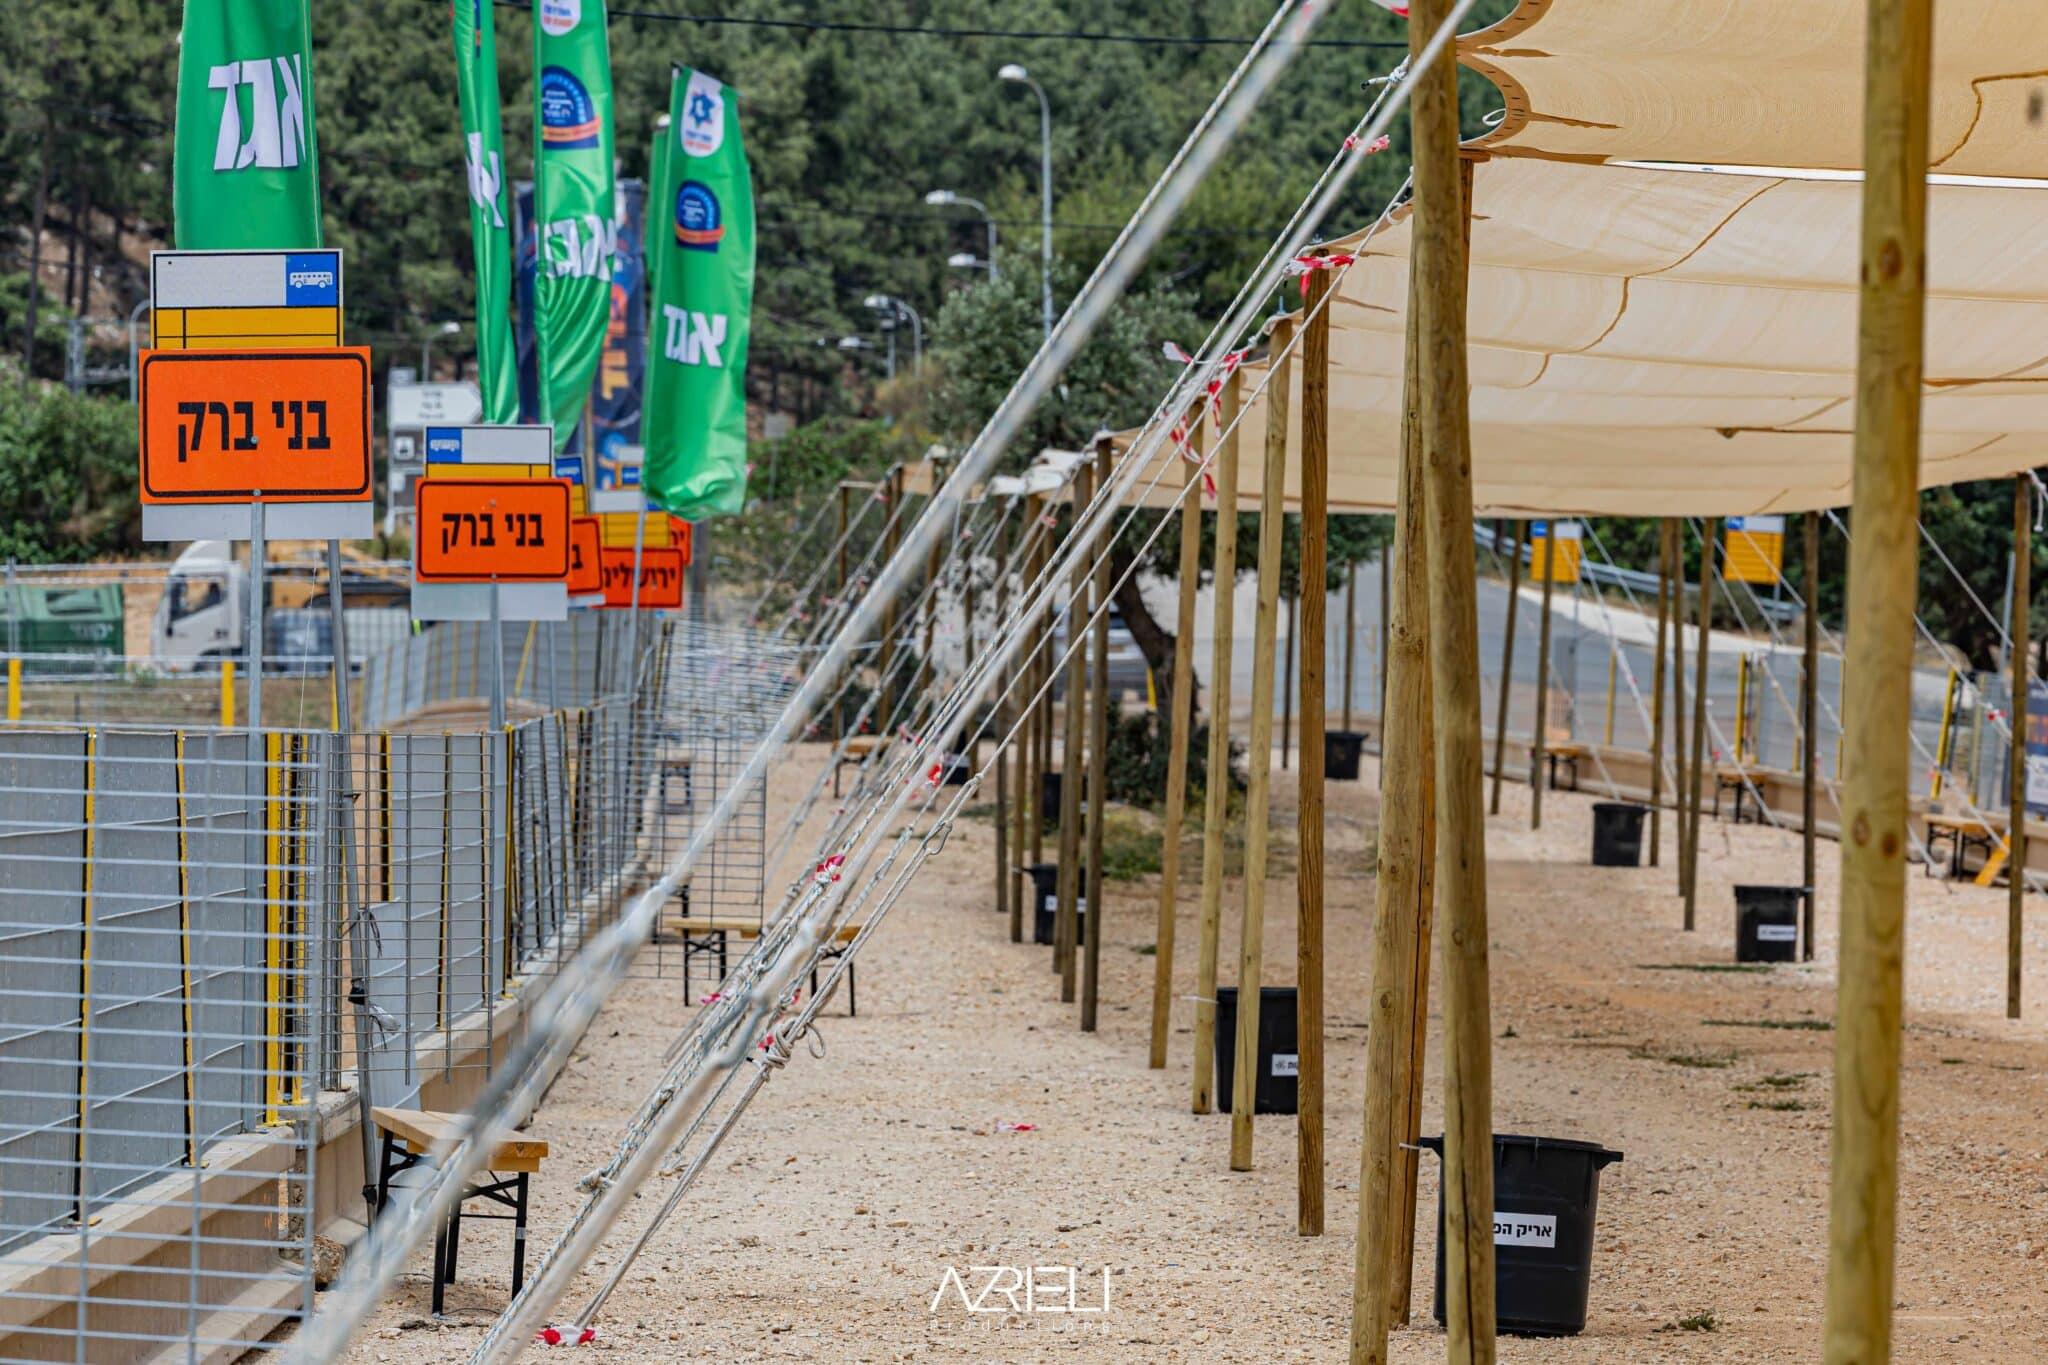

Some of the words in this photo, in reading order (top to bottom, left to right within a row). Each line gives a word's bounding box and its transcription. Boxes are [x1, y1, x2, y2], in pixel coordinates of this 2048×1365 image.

[207, 53, 306, 171] אגד
[177, 400, 258, 463] ברק
[271, 400, 331, 450] בני
[442, 513, 496, 554] ברק
[504, 513, 545, 547] בני
[1516, 1224, 1552, 1238] אריק
